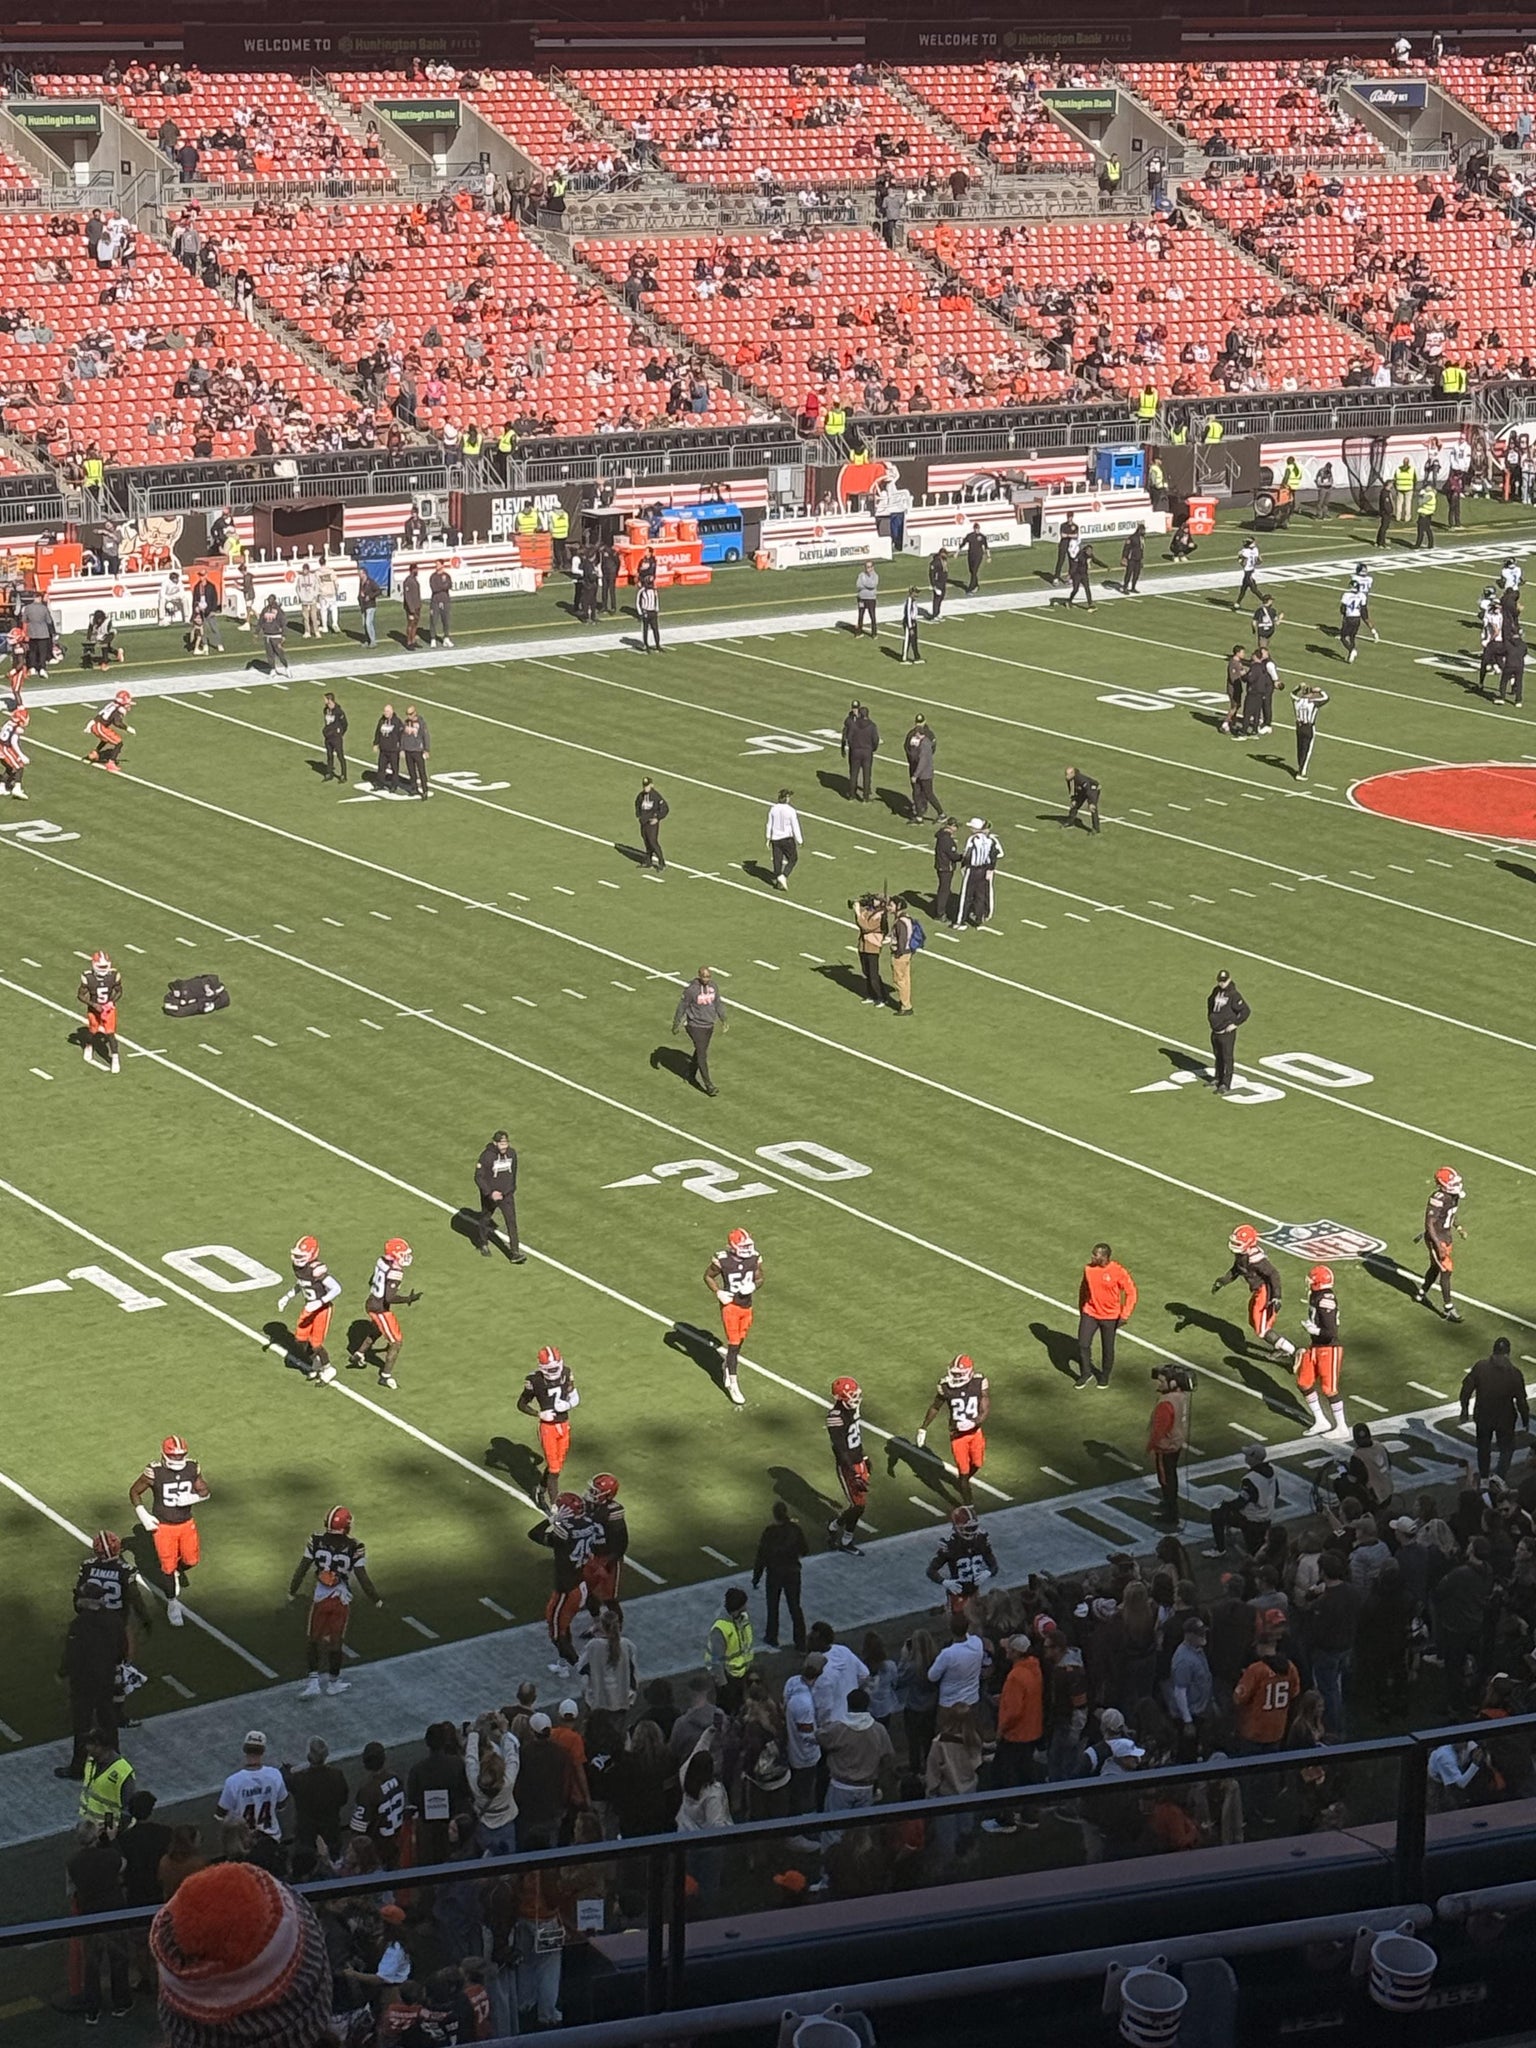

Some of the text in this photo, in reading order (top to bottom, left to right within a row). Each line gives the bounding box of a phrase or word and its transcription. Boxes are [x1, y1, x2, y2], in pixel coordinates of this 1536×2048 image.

[244, 38, 311, 52] WELCOME
[314, 38, 331, 51] TO
[355, 38, 416, 54] Huntington
[418, 38, 447, 51] Bank
[919, 33, 978, 46] WELCOME
[981, 33, 997, 46] TO
[1018, 33, 1075, 47] Huntington
[1077, 33, 1102, 44] Bank
[1054, 98, 1112, 110] Huntington Bank
[27, 114, 96, 127] Huntington Bank
[391, 109, 455, 122] Huntington Bank
[656, 553, 692, 564] TORADE
[799, 547, 838, 561] CLEVELAND
[96, 986, 110, 1004] 5
[1169, 1052, 1375, 1104] 30
[651, 1141, 873, 1203] 20
[67, 1244, 283, 1313] 10
[951, 1395, 979, 1421] 24
[1261, 1680, 1289, 1712] 16
[242, 1800, 273, 1831] 44
